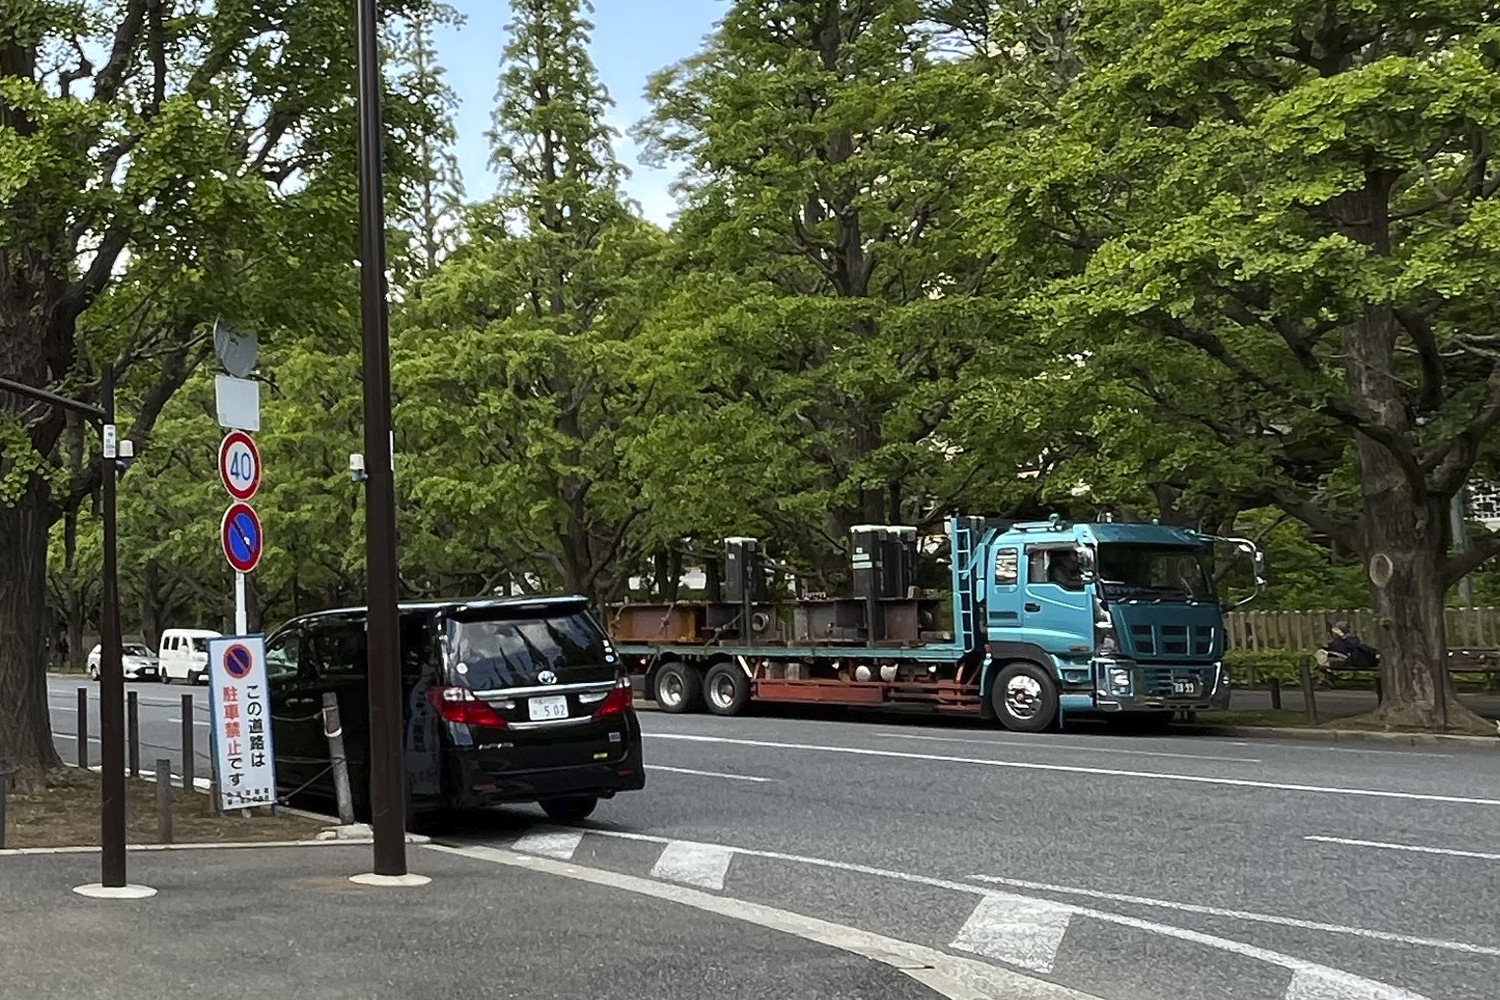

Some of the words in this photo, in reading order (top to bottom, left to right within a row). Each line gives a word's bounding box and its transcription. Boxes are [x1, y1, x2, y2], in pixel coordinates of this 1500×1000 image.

[230, 451, 252, 481] 40
[222, 685, 245, 787] 駐車禁止です
[246, 684, 266, 768] この道路は
